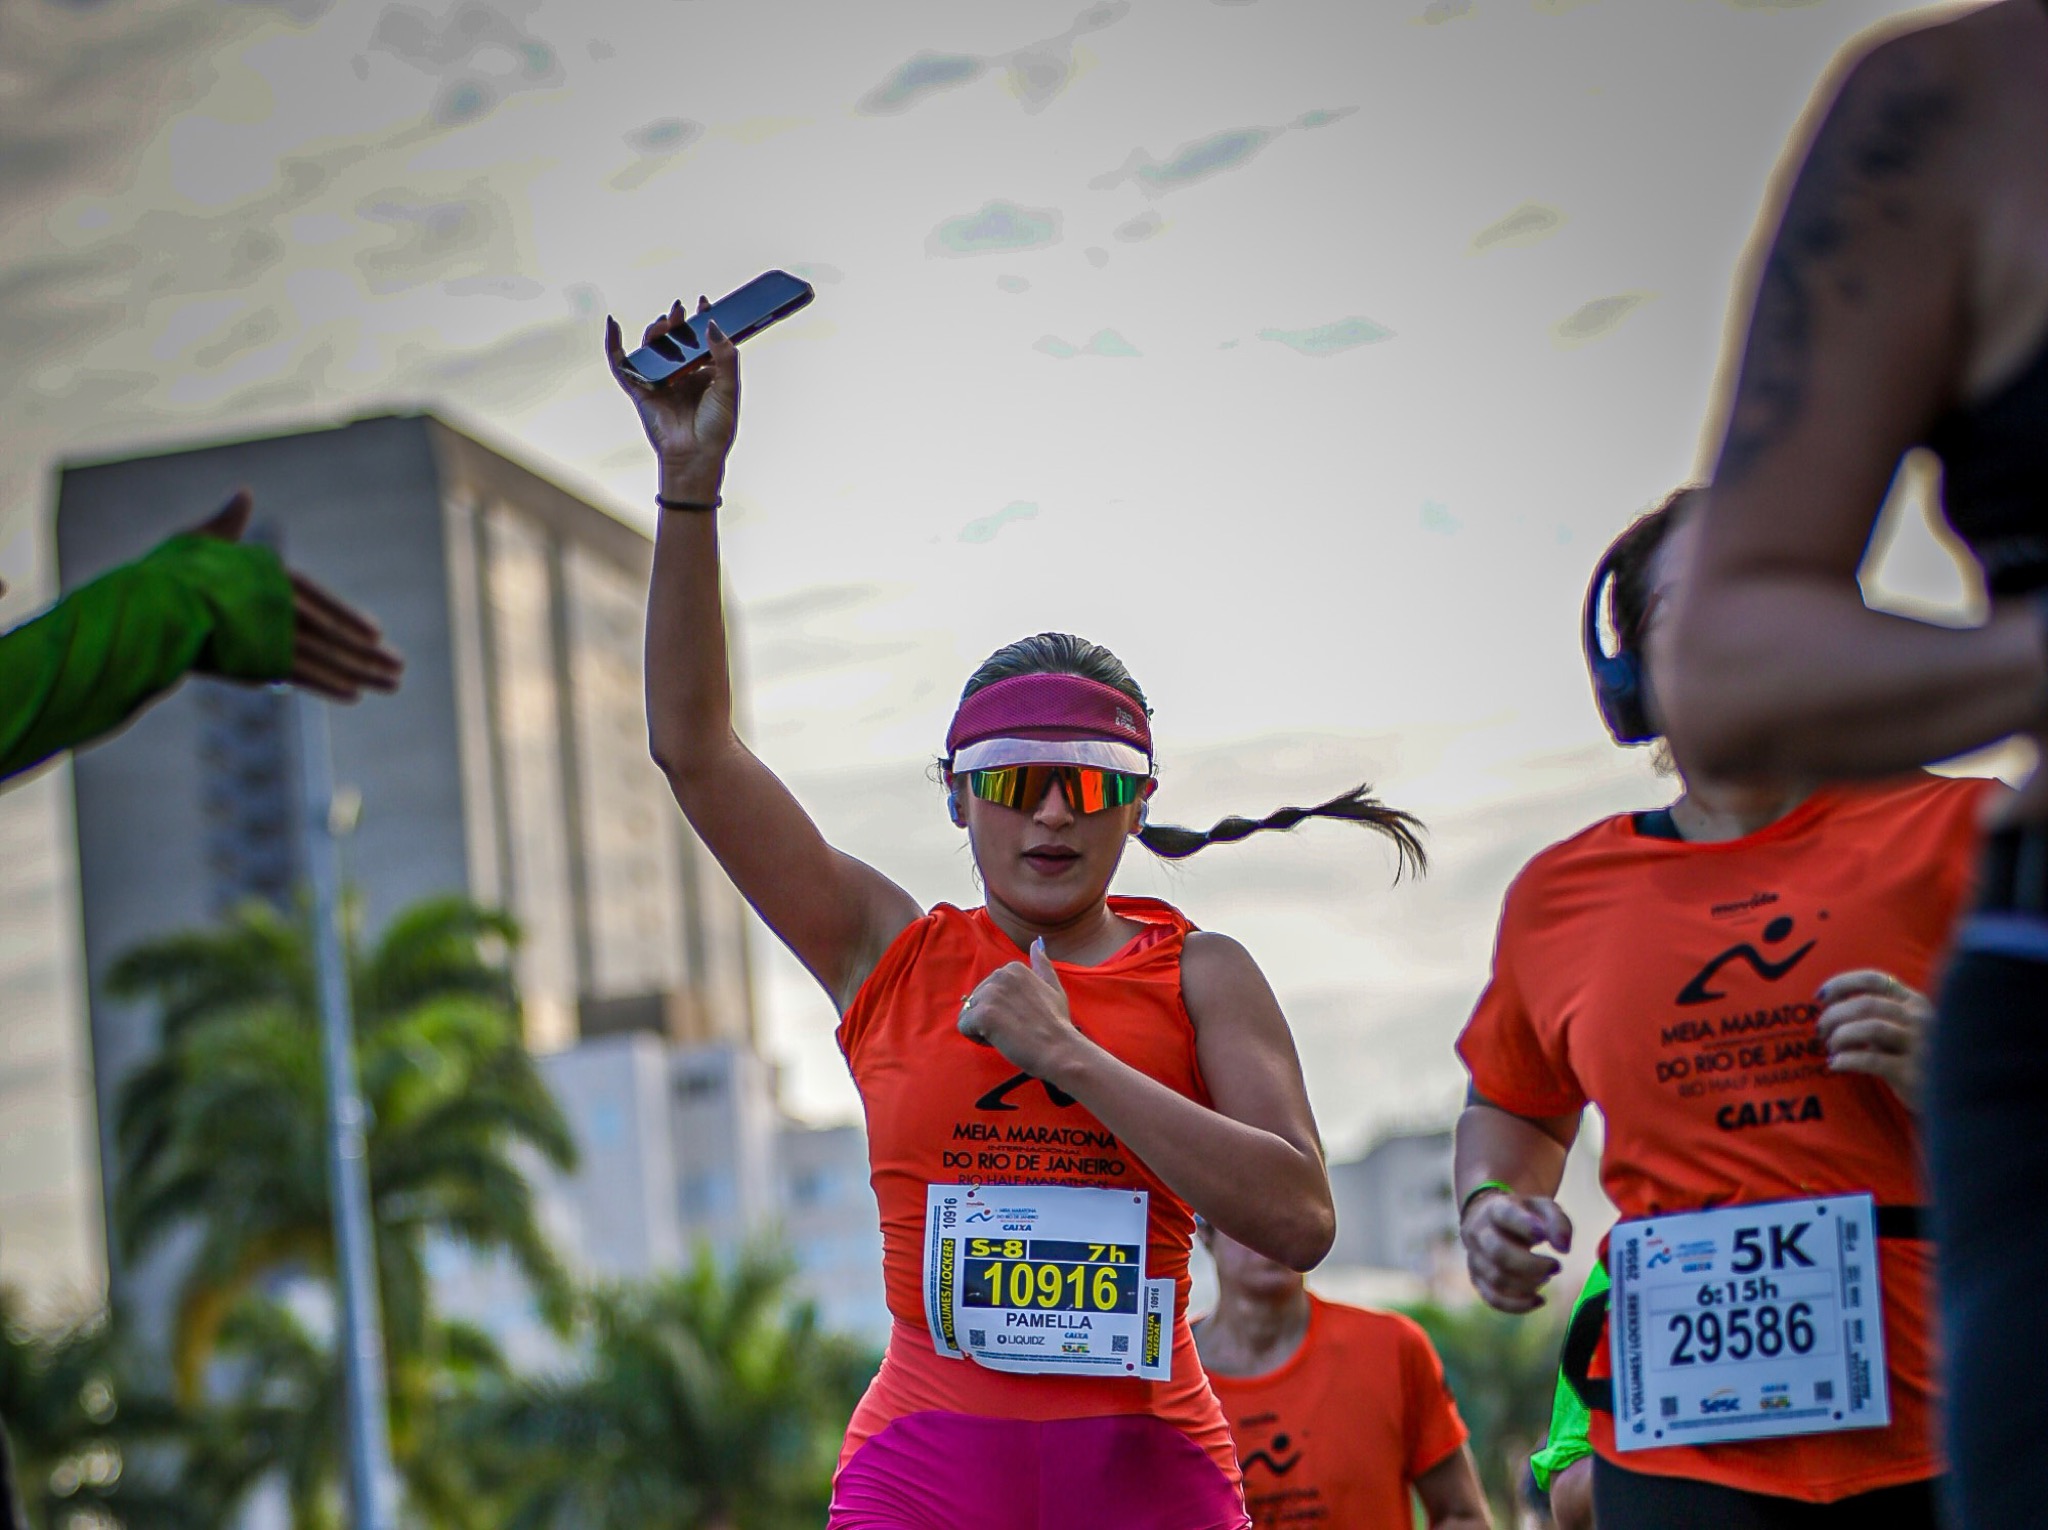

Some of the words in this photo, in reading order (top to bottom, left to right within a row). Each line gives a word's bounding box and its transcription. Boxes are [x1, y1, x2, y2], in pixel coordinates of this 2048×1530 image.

[1661, 1021, 1715, 1046] MEIA
[1721, 1004, 1819, 1035] MARATON
[1656, 1057, 1689, 1083] DO
[1695, 1051, 1733, 1074] RIO
[1739, 1046, 1766, 1069] DE
[1716, 1095, 1823, 1131] CAIXA
[952, 1123, 1000, 1142] MEIA
[1006, 1125, 1118, 1150] MARATONA
[943, 1151, 973, 1168] DO
[978, 1152, 1010, 1170] RIO
[1016, 1154, 1040, 1171] DE
[1044, 1155, 1125, 1177] JANEIRO
[958, 1174, 982, 1185] RIO
[987, 1175, 1021, 1186] HALF
[943, 1198, 957, 1229] 10916
[970, 1239, 1024, 1259] S-8
[1088, 1245, 1126, 1263] 7h
[1731, 1221, 1816, 1274] 5K
[941, 1239, 954, 1338] VOLUMES/LOCKERS
[984, 1262, 1118, 1311] 10916
[1150, 1287, 1160, 1309] 10916
[1697, 1276, 1779, 1306] 6:15h
[1006, 1312, 1092, 1330] PAMELLA
[1668, 1302, 1815, 1366] 29586
[1008, 1334, 1046, 1345] LIQUIDZ
[1146, 1315, 1155, 1364] MEDALHA
[1152, 1323, 1160, 1357] MEDAL
[1626, 1294, 1645, 1415] VOLUMES/LOCKERS
